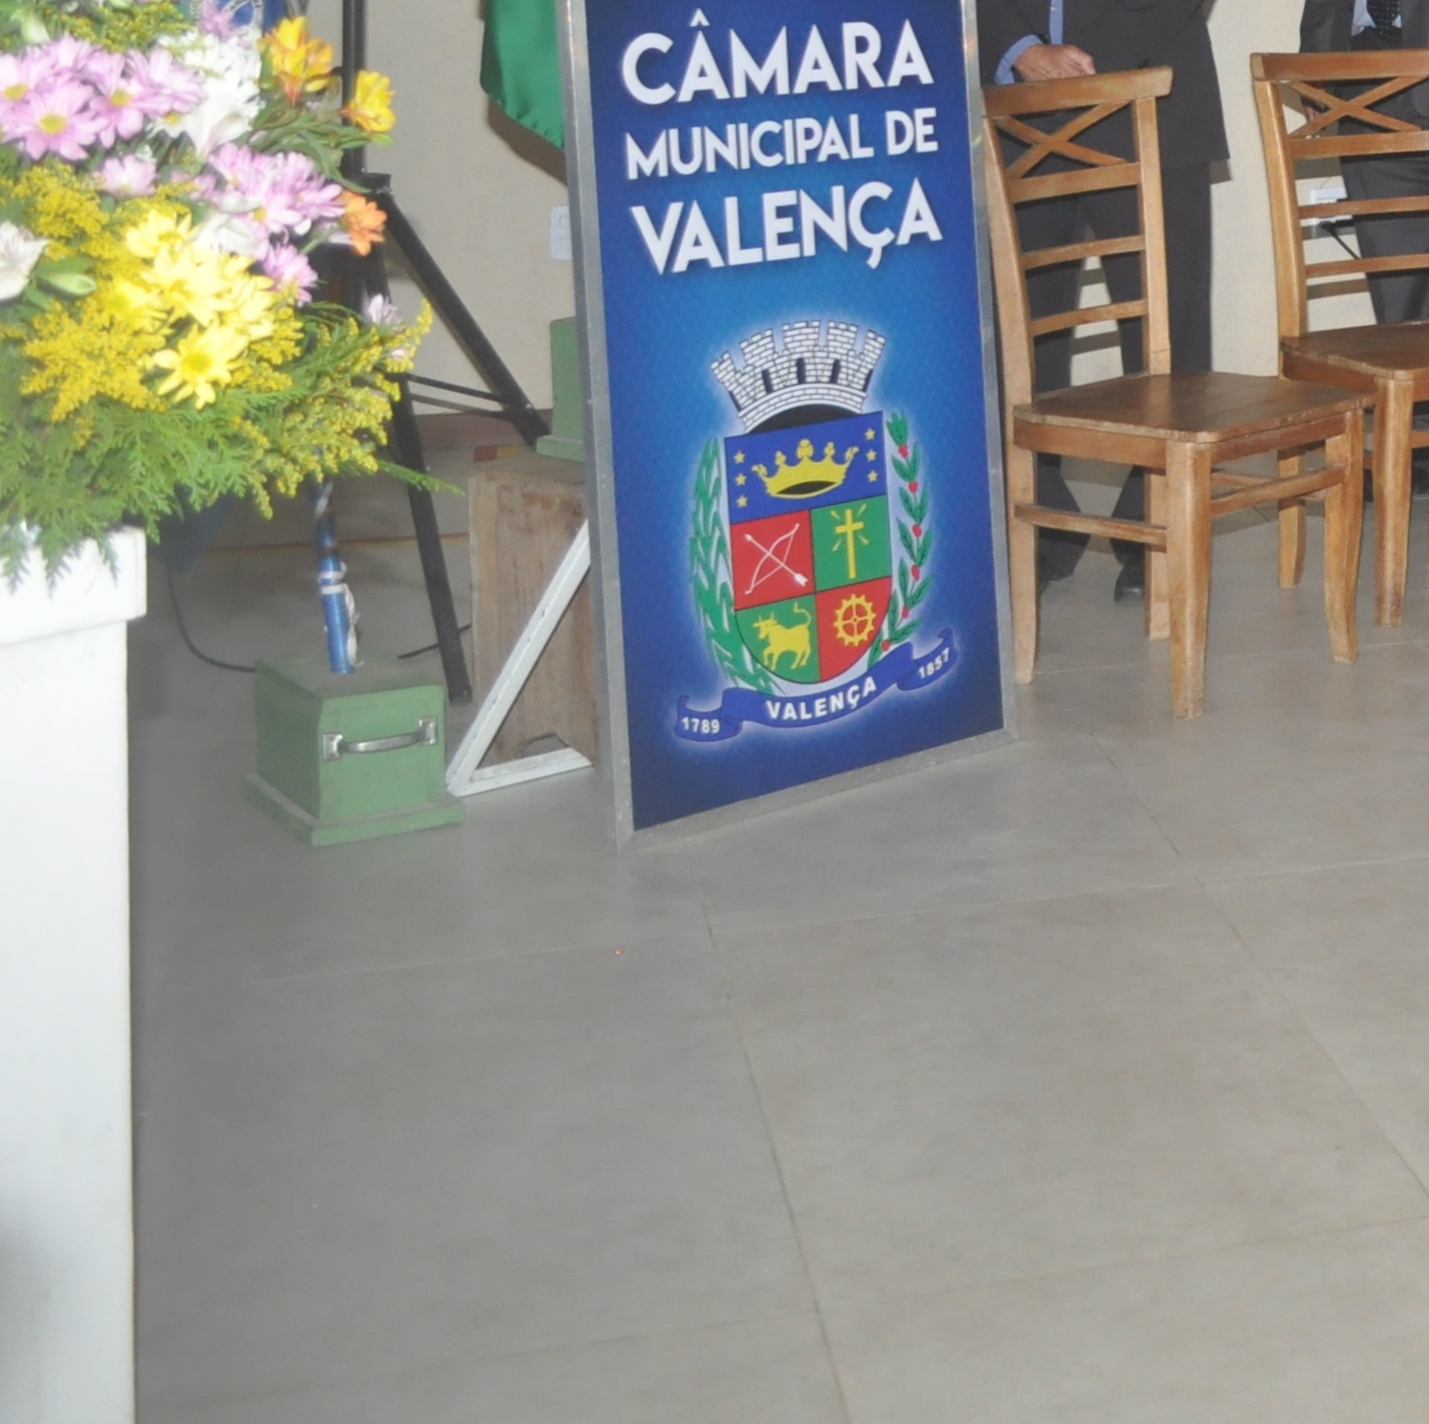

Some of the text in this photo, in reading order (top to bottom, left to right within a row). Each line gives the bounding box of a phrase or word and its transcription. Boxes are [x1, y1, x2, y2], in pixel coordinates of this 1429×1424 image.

[621, 8, 934, 105] CÂMARA
[625, 107, 939, 180] MUNICIPAL DE
[630, 177, 943, 275] VALENÇA
[681, 648, 950, 734] 1789 VALENÇA 1857
